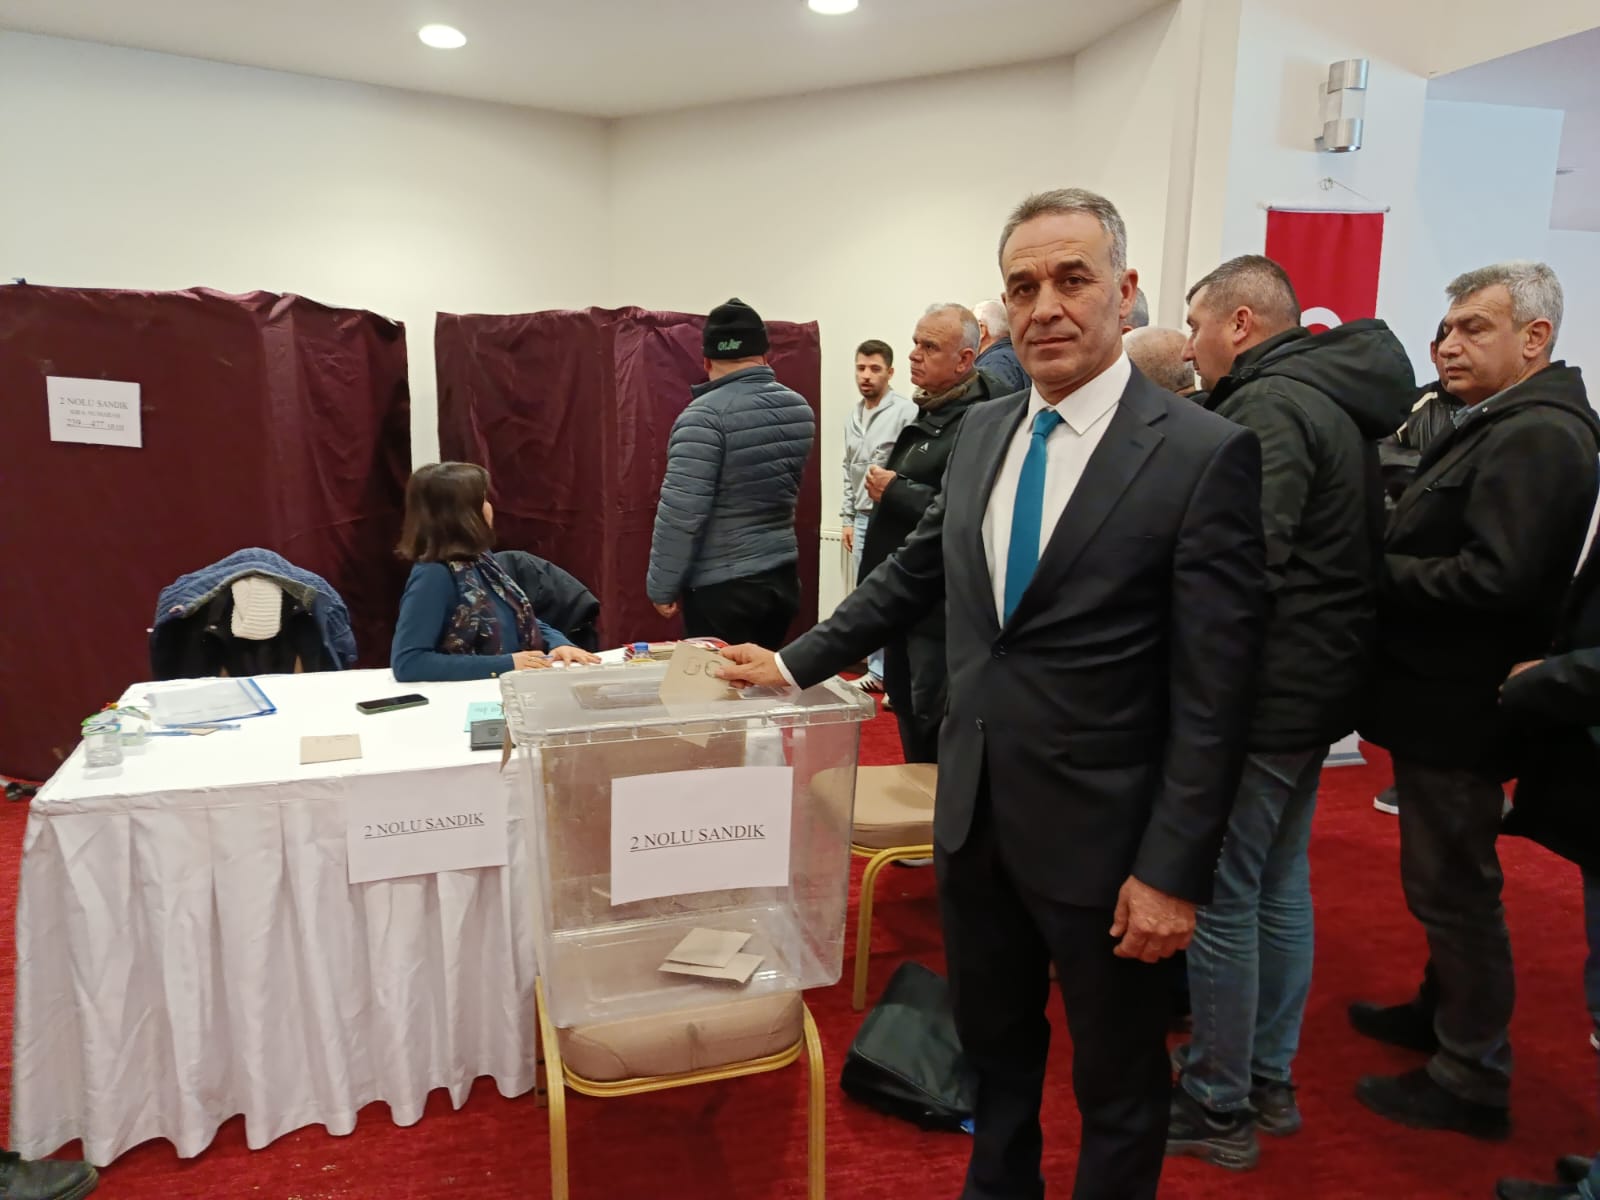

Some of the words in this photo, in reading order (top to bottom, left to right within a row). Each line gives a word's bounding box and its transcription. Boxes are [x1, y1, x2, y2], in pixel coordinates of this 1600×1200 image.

[67, 397, 95, 407] NOLU
[96, 399, 129, 410] SANDIK
[364, 825, 372, 837] 2
[377, 819, 422, 836] NOLU
[425, 812, 484, 830] SANDIK
[630, 836, 639, 850] 2
[644, 829, 694, 848] NOLU
[698, 824, 766, 842] SANDIK
